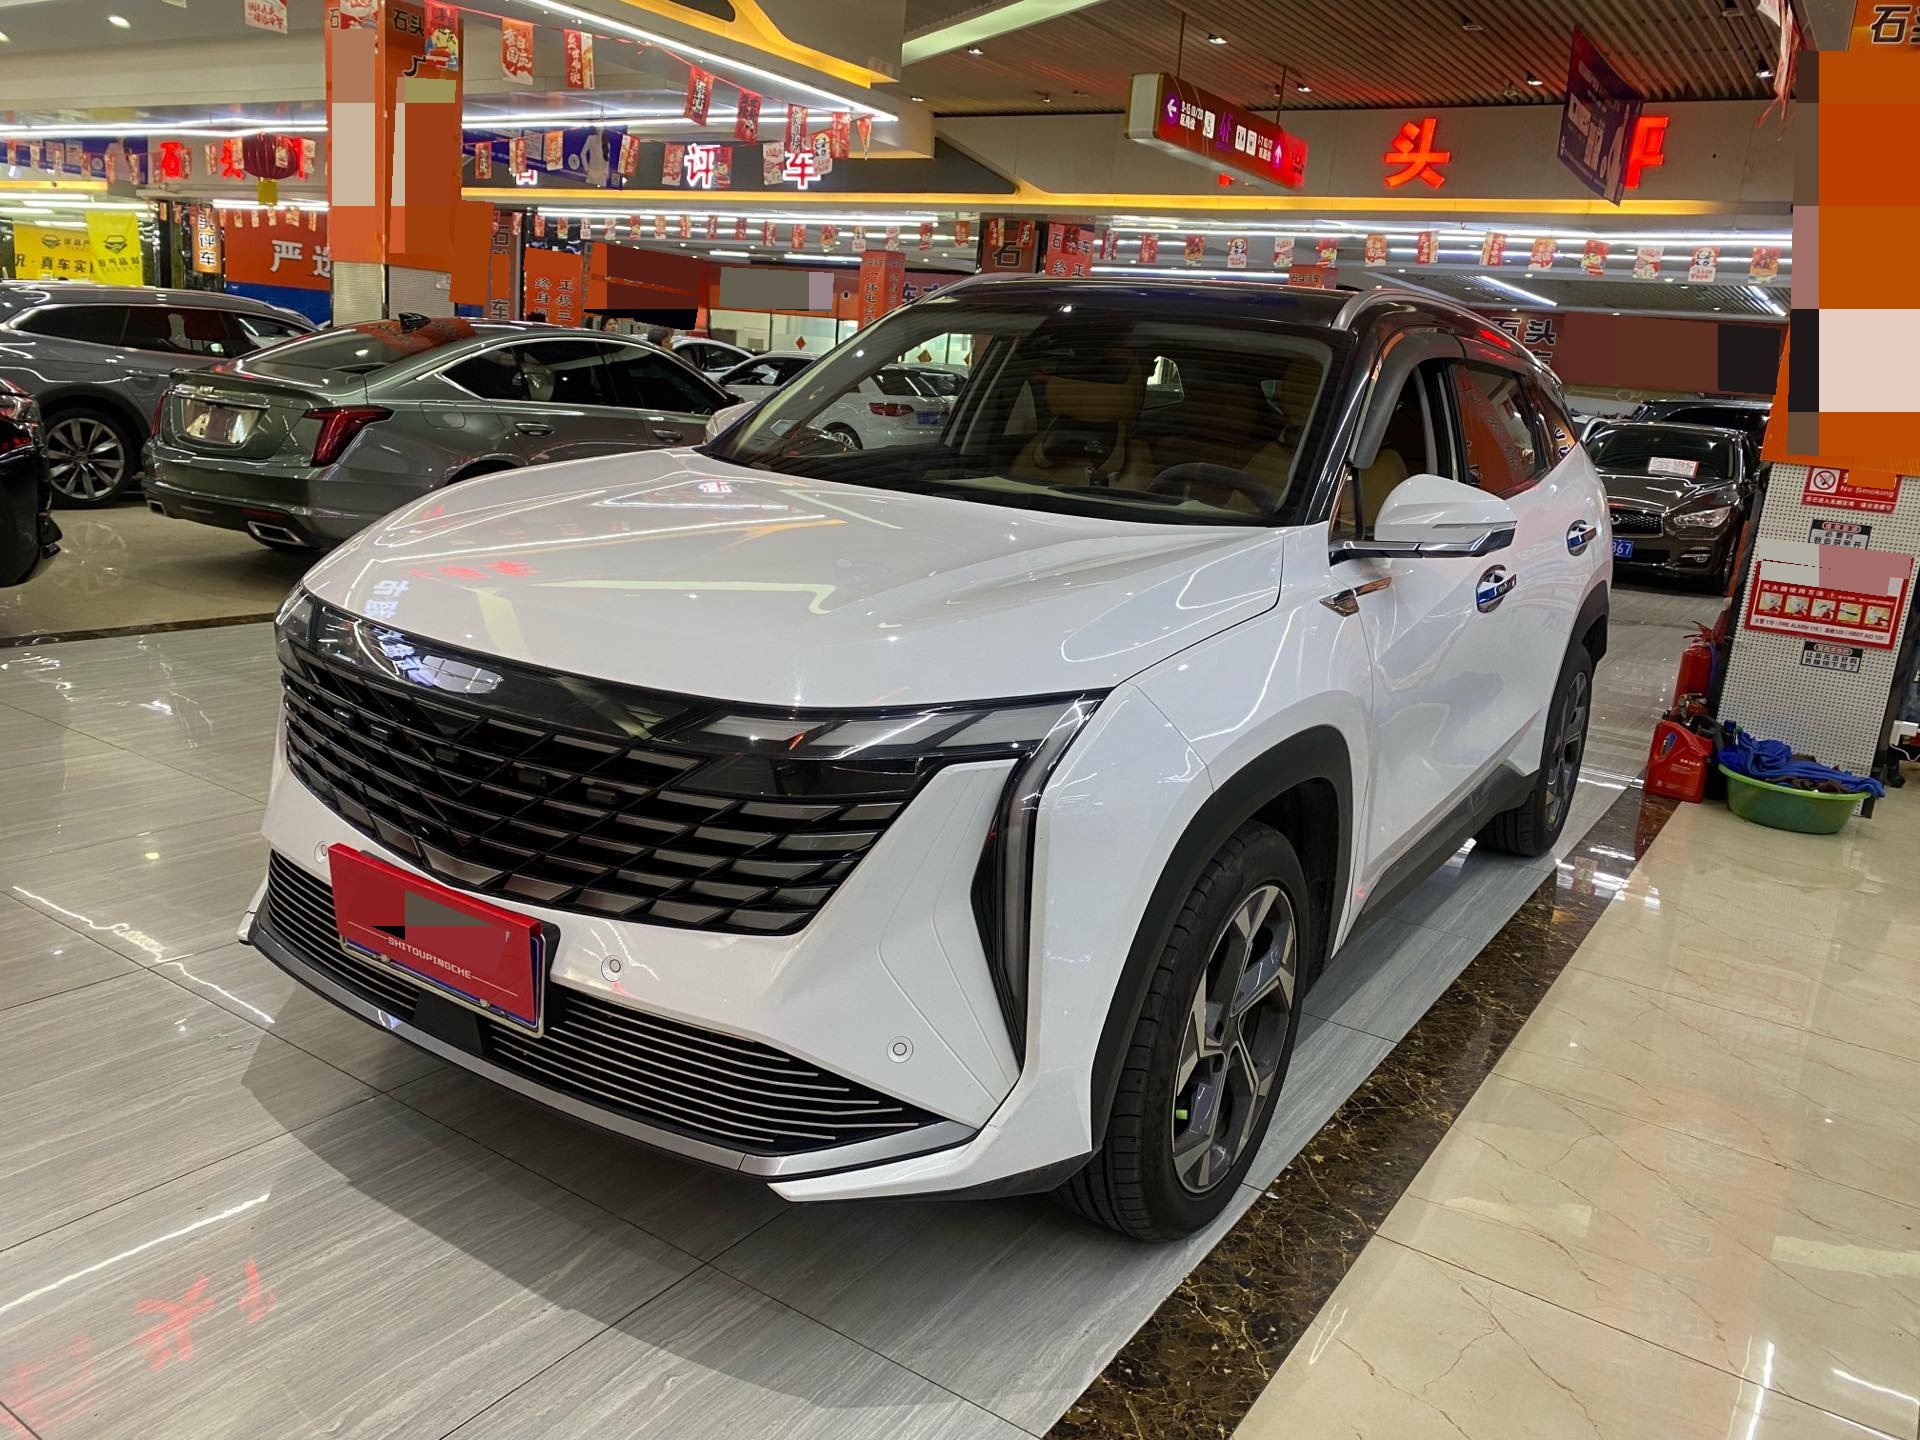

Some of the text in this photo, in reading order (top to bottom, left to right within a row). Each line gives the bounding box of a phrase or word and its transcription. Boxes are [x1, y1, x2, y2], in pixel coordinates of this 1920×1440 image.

[393, 8, 425, 37] 石头
[1840, 485, 1895, 498] No Smoking
[387, 936, 472, 979] SHITOUPINGCHE
